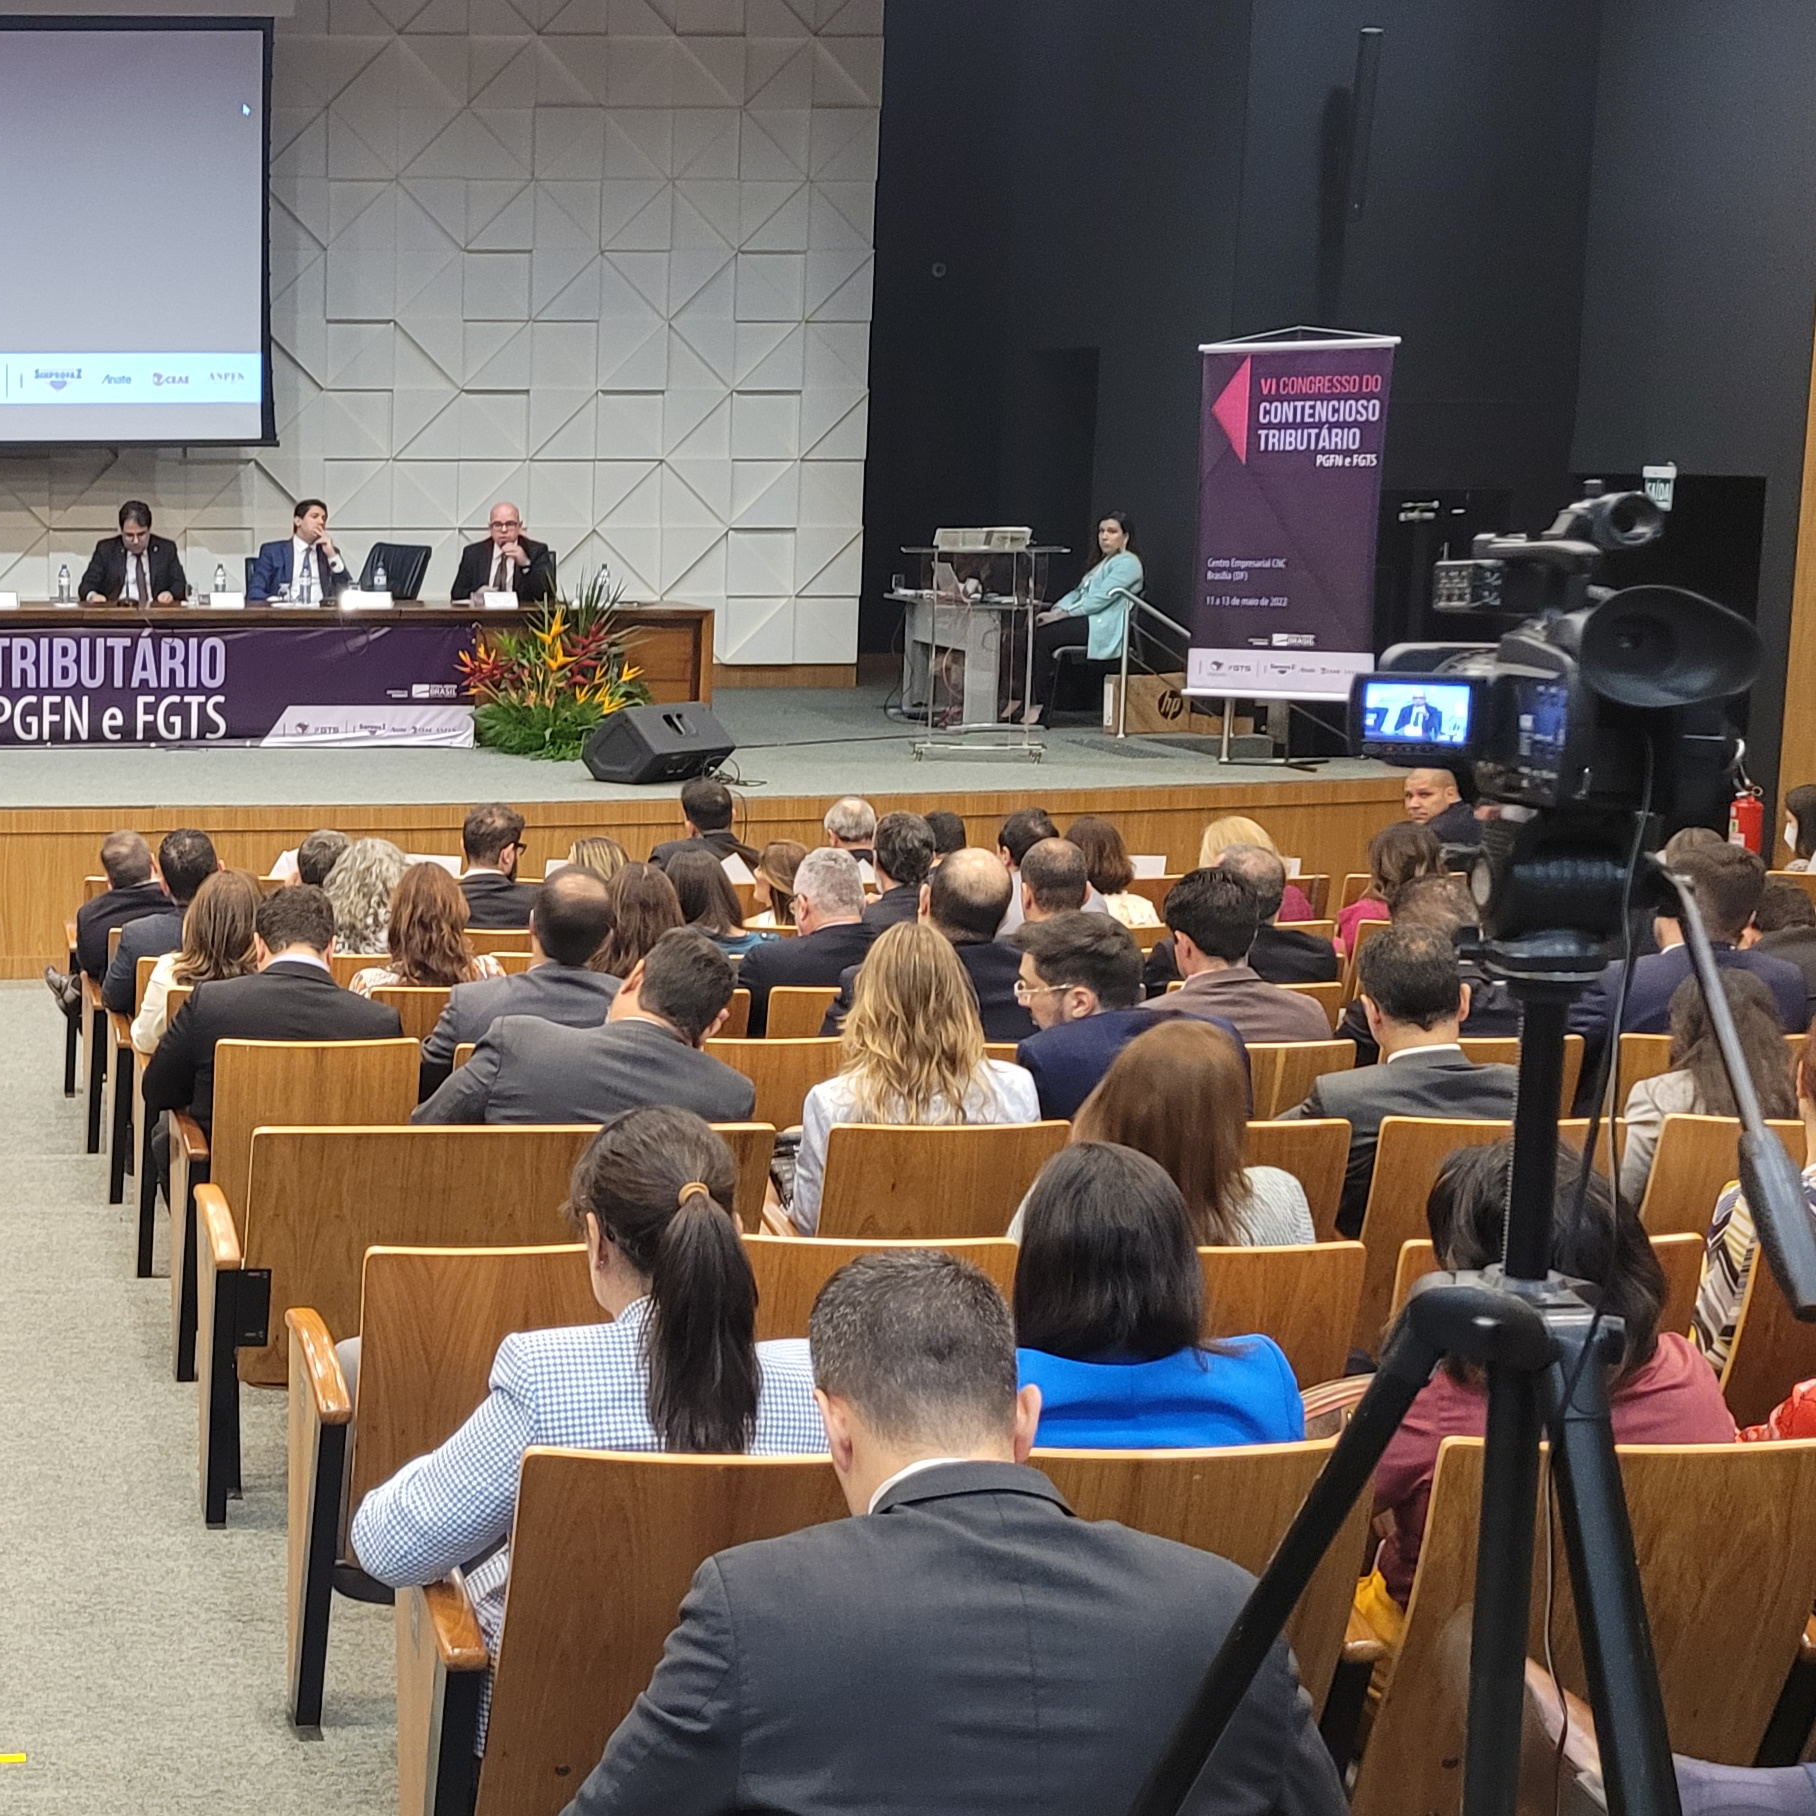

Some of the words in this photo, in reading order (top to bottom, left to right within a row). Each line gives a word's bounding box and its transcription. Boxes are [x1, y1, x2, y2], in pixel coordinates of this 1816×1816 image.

[1261, 378, 1277, 395] VI
[1279, 375, 1359, 394] CONGRESSO
[1362, 375, 1382, 392] DO
[1259, 399, 1381, 424] CONTENCIOSO
[1257, 424, 1361, 451] TRIBUTÁRIO
[1316, 454, 1344, 467] PGFN
[1344, 457, 1352, 467] e
[1352, 454, 1378, 467] FGTS
[429, 687, 457, 696] BRASIL
[102, 706, 123, 741] e
[136, 695, 227, 741] FGTS
[1160, 690, 1182, 721] hp
